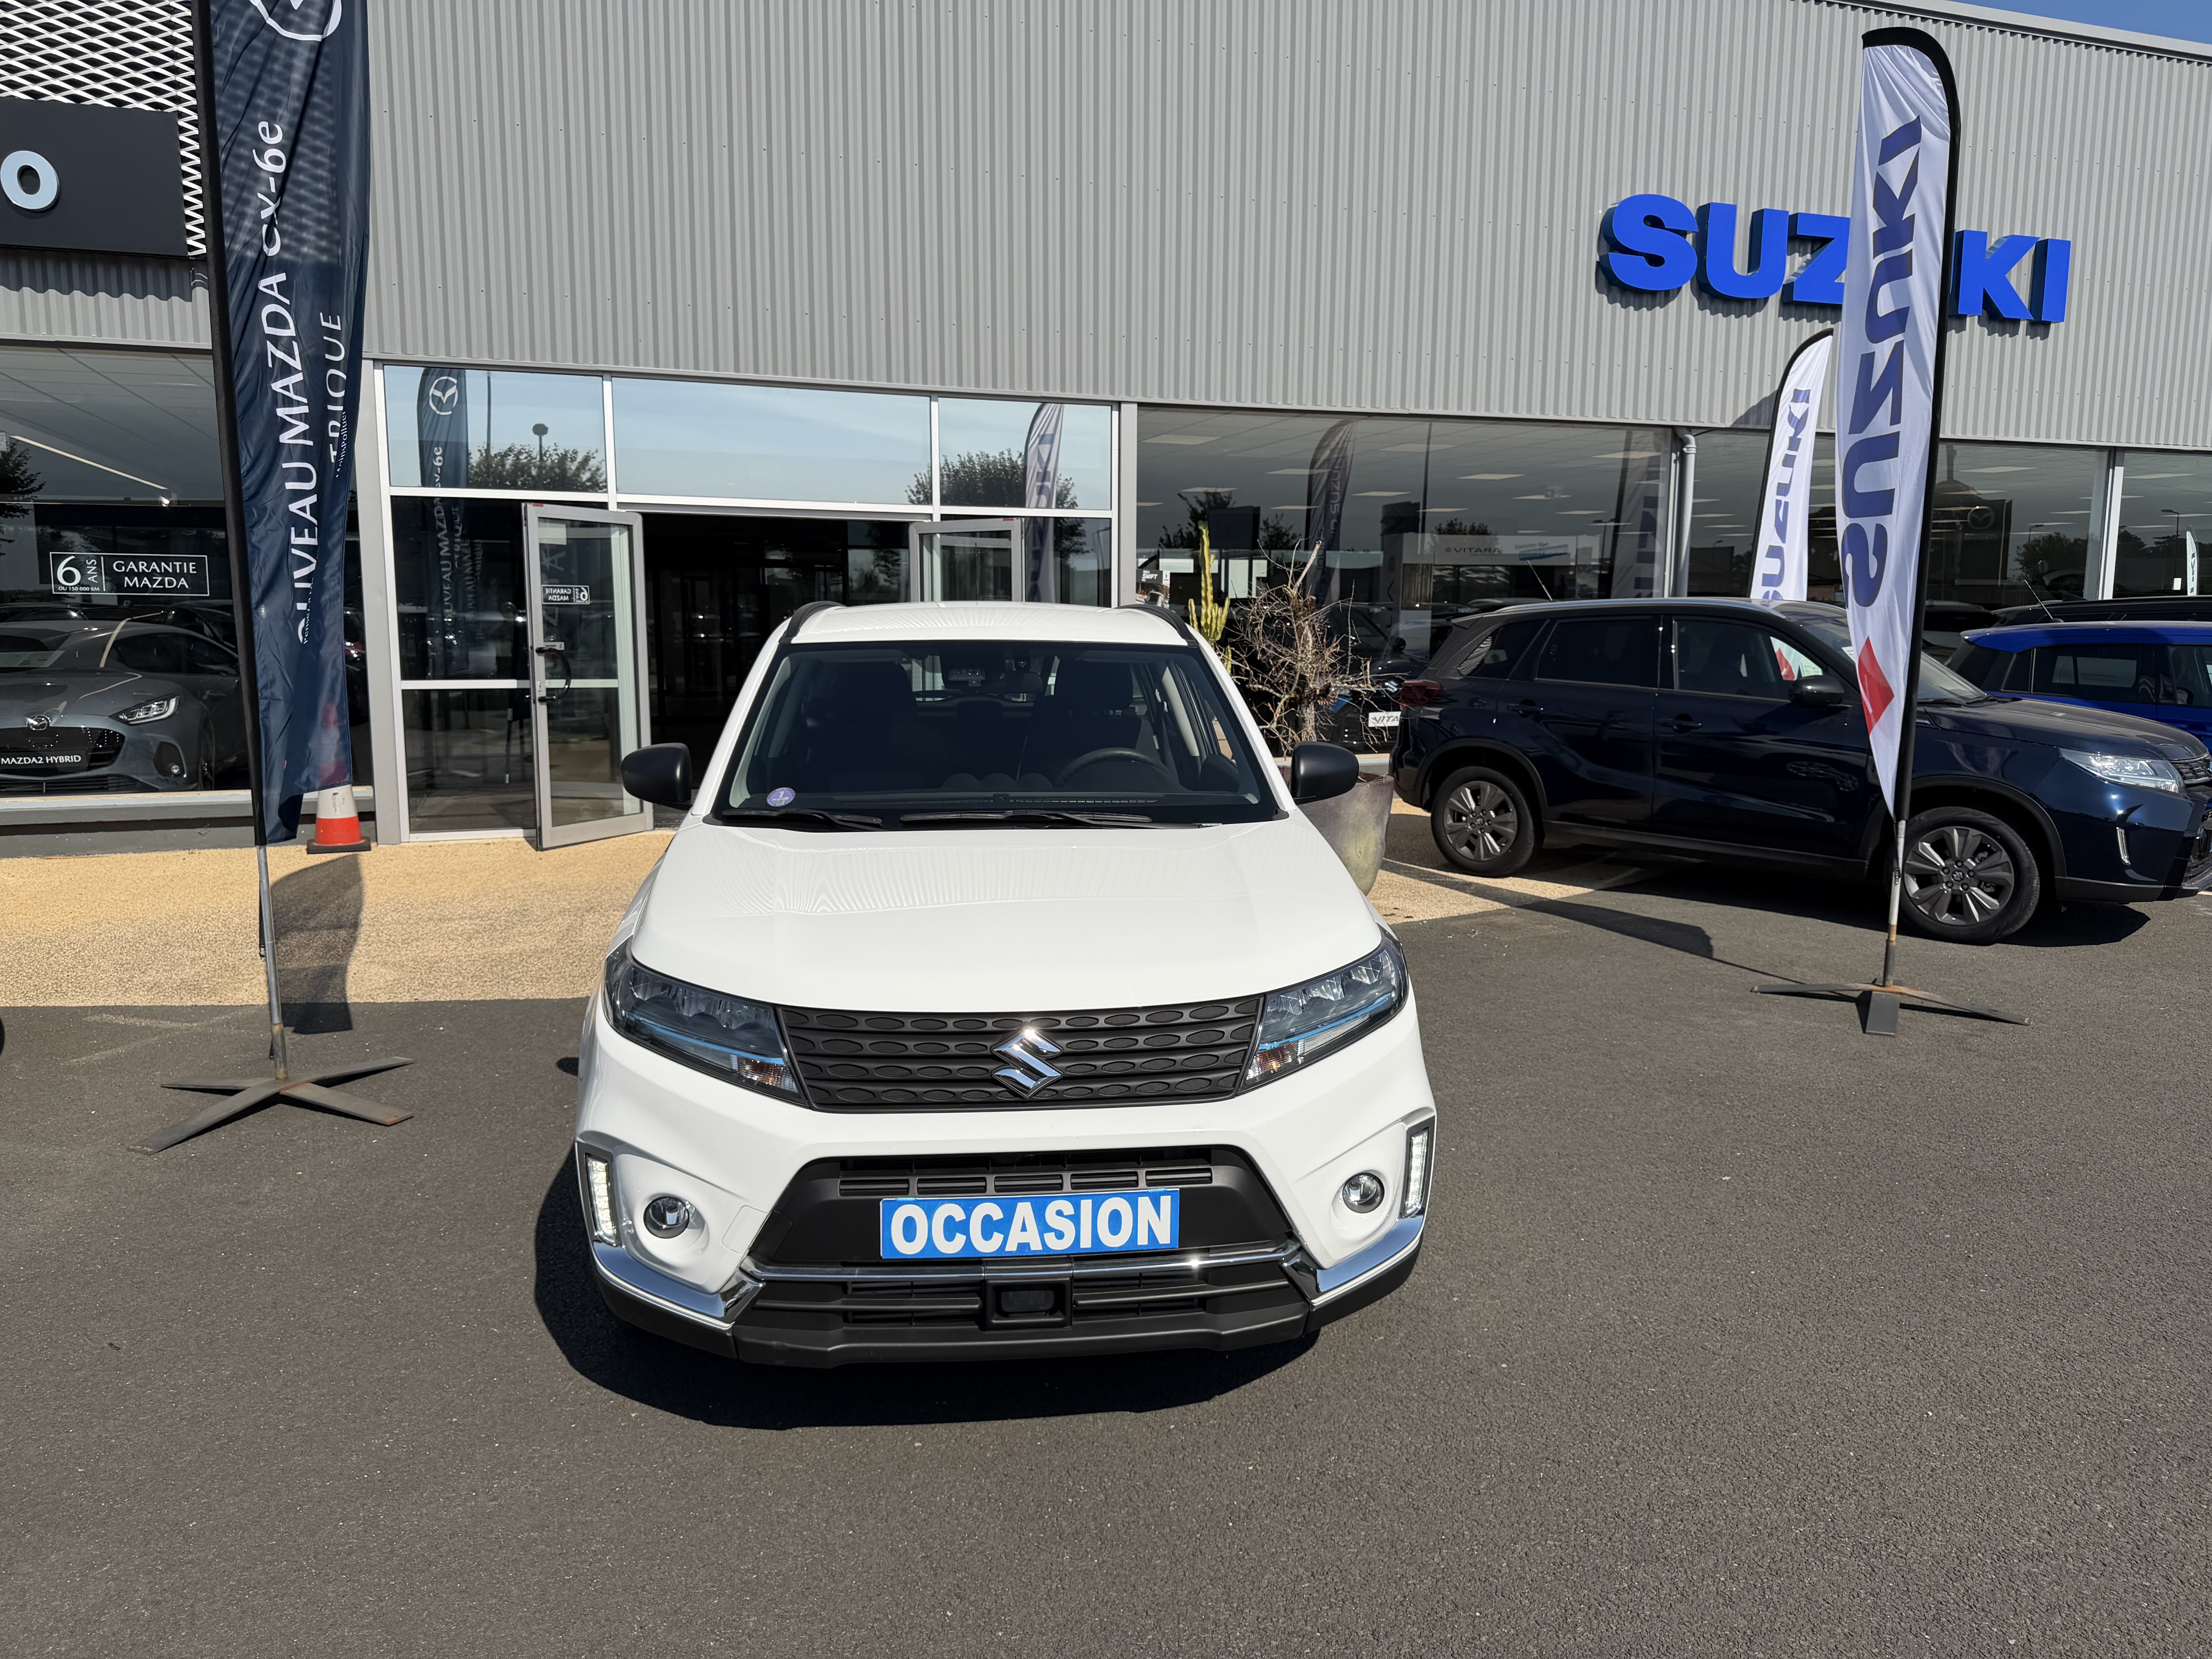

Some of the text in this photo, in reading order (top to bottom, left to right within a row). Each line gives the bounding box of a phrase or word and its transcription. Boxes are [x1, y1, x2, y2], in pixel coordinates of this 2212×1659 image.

[1601, 194, 2071, 323] SUZKI
[258, 272, 314, 446] MAZDA
[57, 556, 98, 586] 6 ANS
[113, 561, 197, 574] GARANTIE
[124, 576, 189, 589] MAZDA
[46, 755, 81, 763] HYBRID
[890, 1195, 1172, 1255] OCCASION
